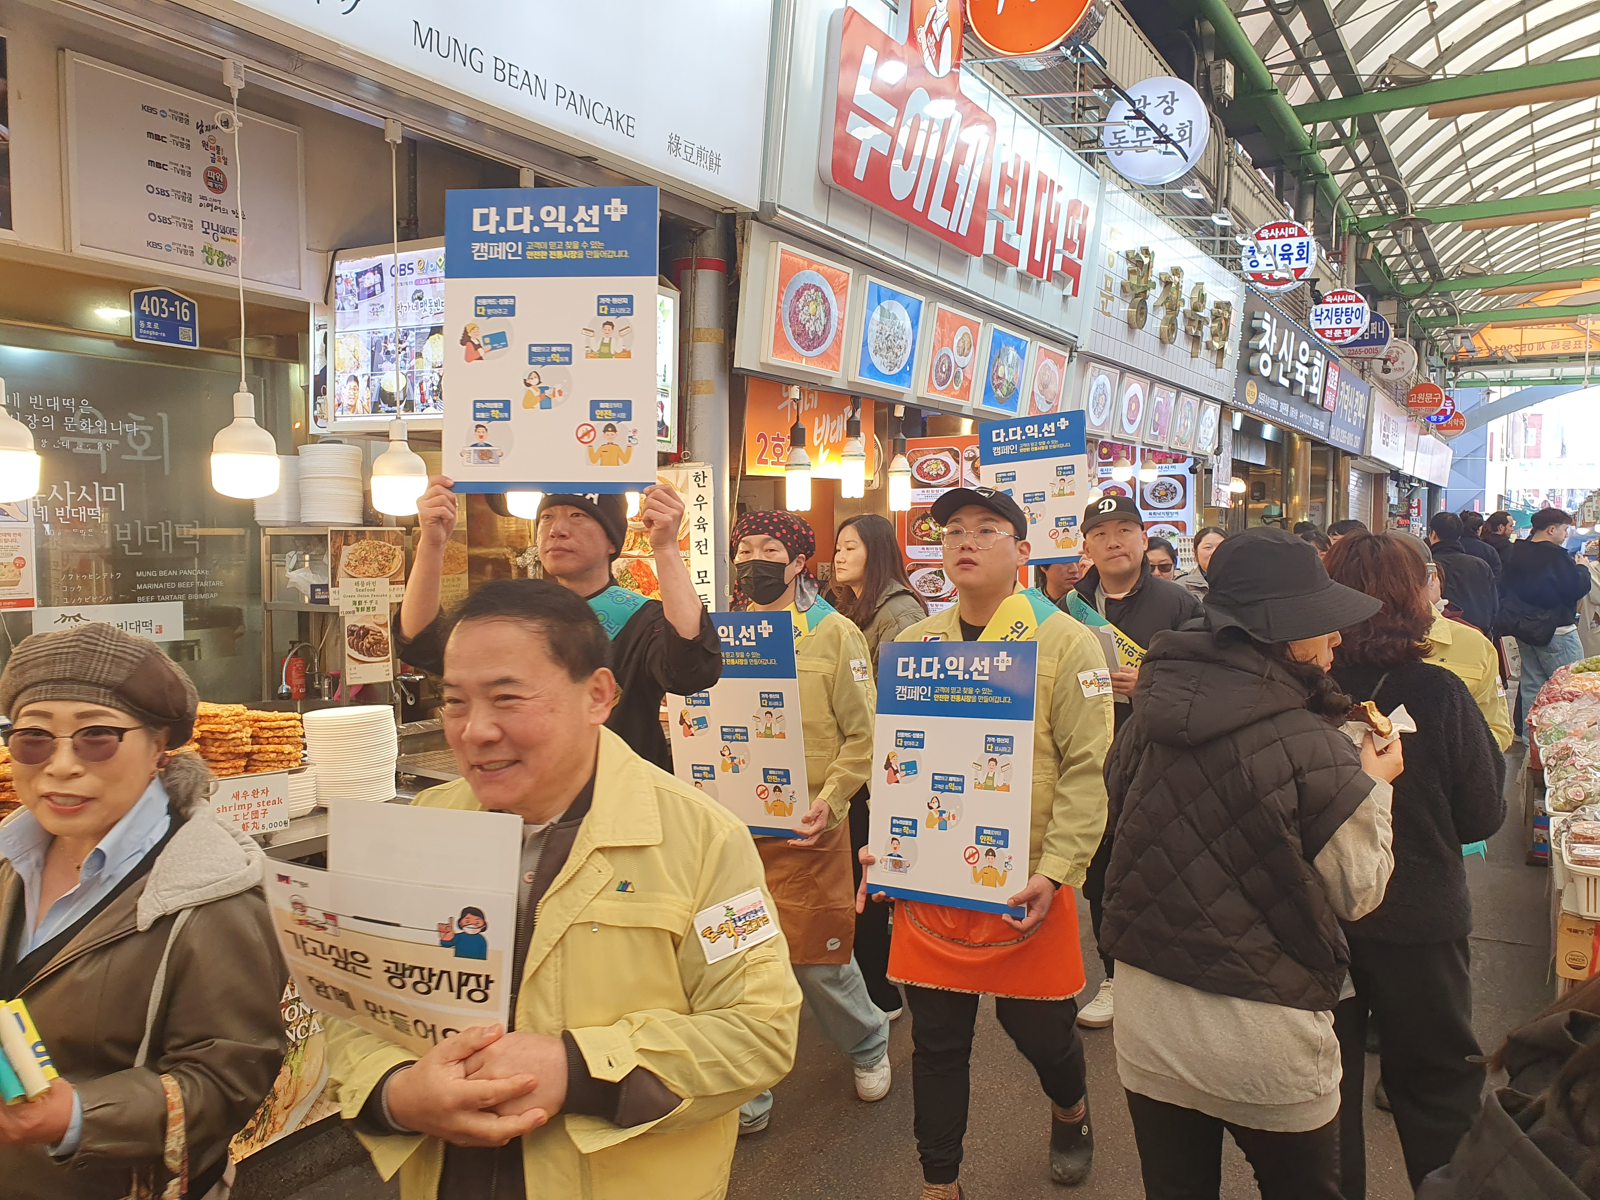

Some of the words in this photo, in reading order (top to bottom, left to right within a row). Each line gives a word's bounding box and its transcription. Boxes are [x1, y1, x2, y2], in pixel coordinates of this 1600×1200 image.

[412, 19, 484, 74] MUNG
[492, 55, 547, 101] BEAN
[554, 83, 636, 138] PANCAKE
[141, 104, 158, 115] KBS
[845, 44, 990, 237] 누이네
[666, 131, 723, 176] 綠豆煎餅
[155, 187, 170, 198] SBS
[157, 215, 172, 225] SBS
[472, 205, 600, 234] 다.다.익.선
[990, 147, 1090, 298] 빈대떡
[1259, 226, 1299, 239] 육사시미
[146, 240, 163, 250] KBS
[471, 242, 522, 261] 캠페인
[581, 241, 589, 250] 수
[590, 241, 605, 250] 있는
[1325, 295, 1356, 304] 육사시미
[140, 295, 190, 322] 403-16
[477, 306, 486, 316] 다
[599, 305, 608, 315] 다
[1314, 305, 1364, 325] 낙지탕탕이
[139, 320, 160, 329] 동호로
[1324, 329, 1352, 338] 전문점
[1256, 311, 1326, 406] 창신육회
[30, 395, 93, 414] 빈대떡은
[1409, 392, 1441, 404] 고원문구
[63, 418, 140, 437] 문화입니다
[992, 421, 1056, 443] 다.다.익.선
[756, 431, 792, 468] 2호
[992, 444, 1018, 456] 캠페인
[55, 503, 102, 525] 빈대떡
[692, 470, 709, 556] 한우육전
[1098, 498, 1117, 514] D
[114, 518, 200, 556] 빈대떡
[136, 570, 157, 578] MUNG
[158, 569, 178, 577] BEAN
[136, 582, 176, 590] MARINATED
[137, 595, 155, 603] BEEF
[156, 594, 187, 602] TARTARE
[187, 592, 218, 600] BIBIMBAP
[896, 656, 991, 681] 다.다.익.선
[895, 685, 931, 701] 캠페인
[975, 687, 981, 695] 수
[981, 687, 993, 695] 있는
[986, 743, 993, 752] 다
[231, 786, 270, 801] 새우완자
[216, 802, 253, 814] shrimp
[256, 796, 283, 808] steak
[261, 819, 289, 831] 5,000원
[284, 929, 373, 980] 가고싶은
[383, 958, 495, 1004] 광장시장
[306, 975, 356, 1011] 함께
